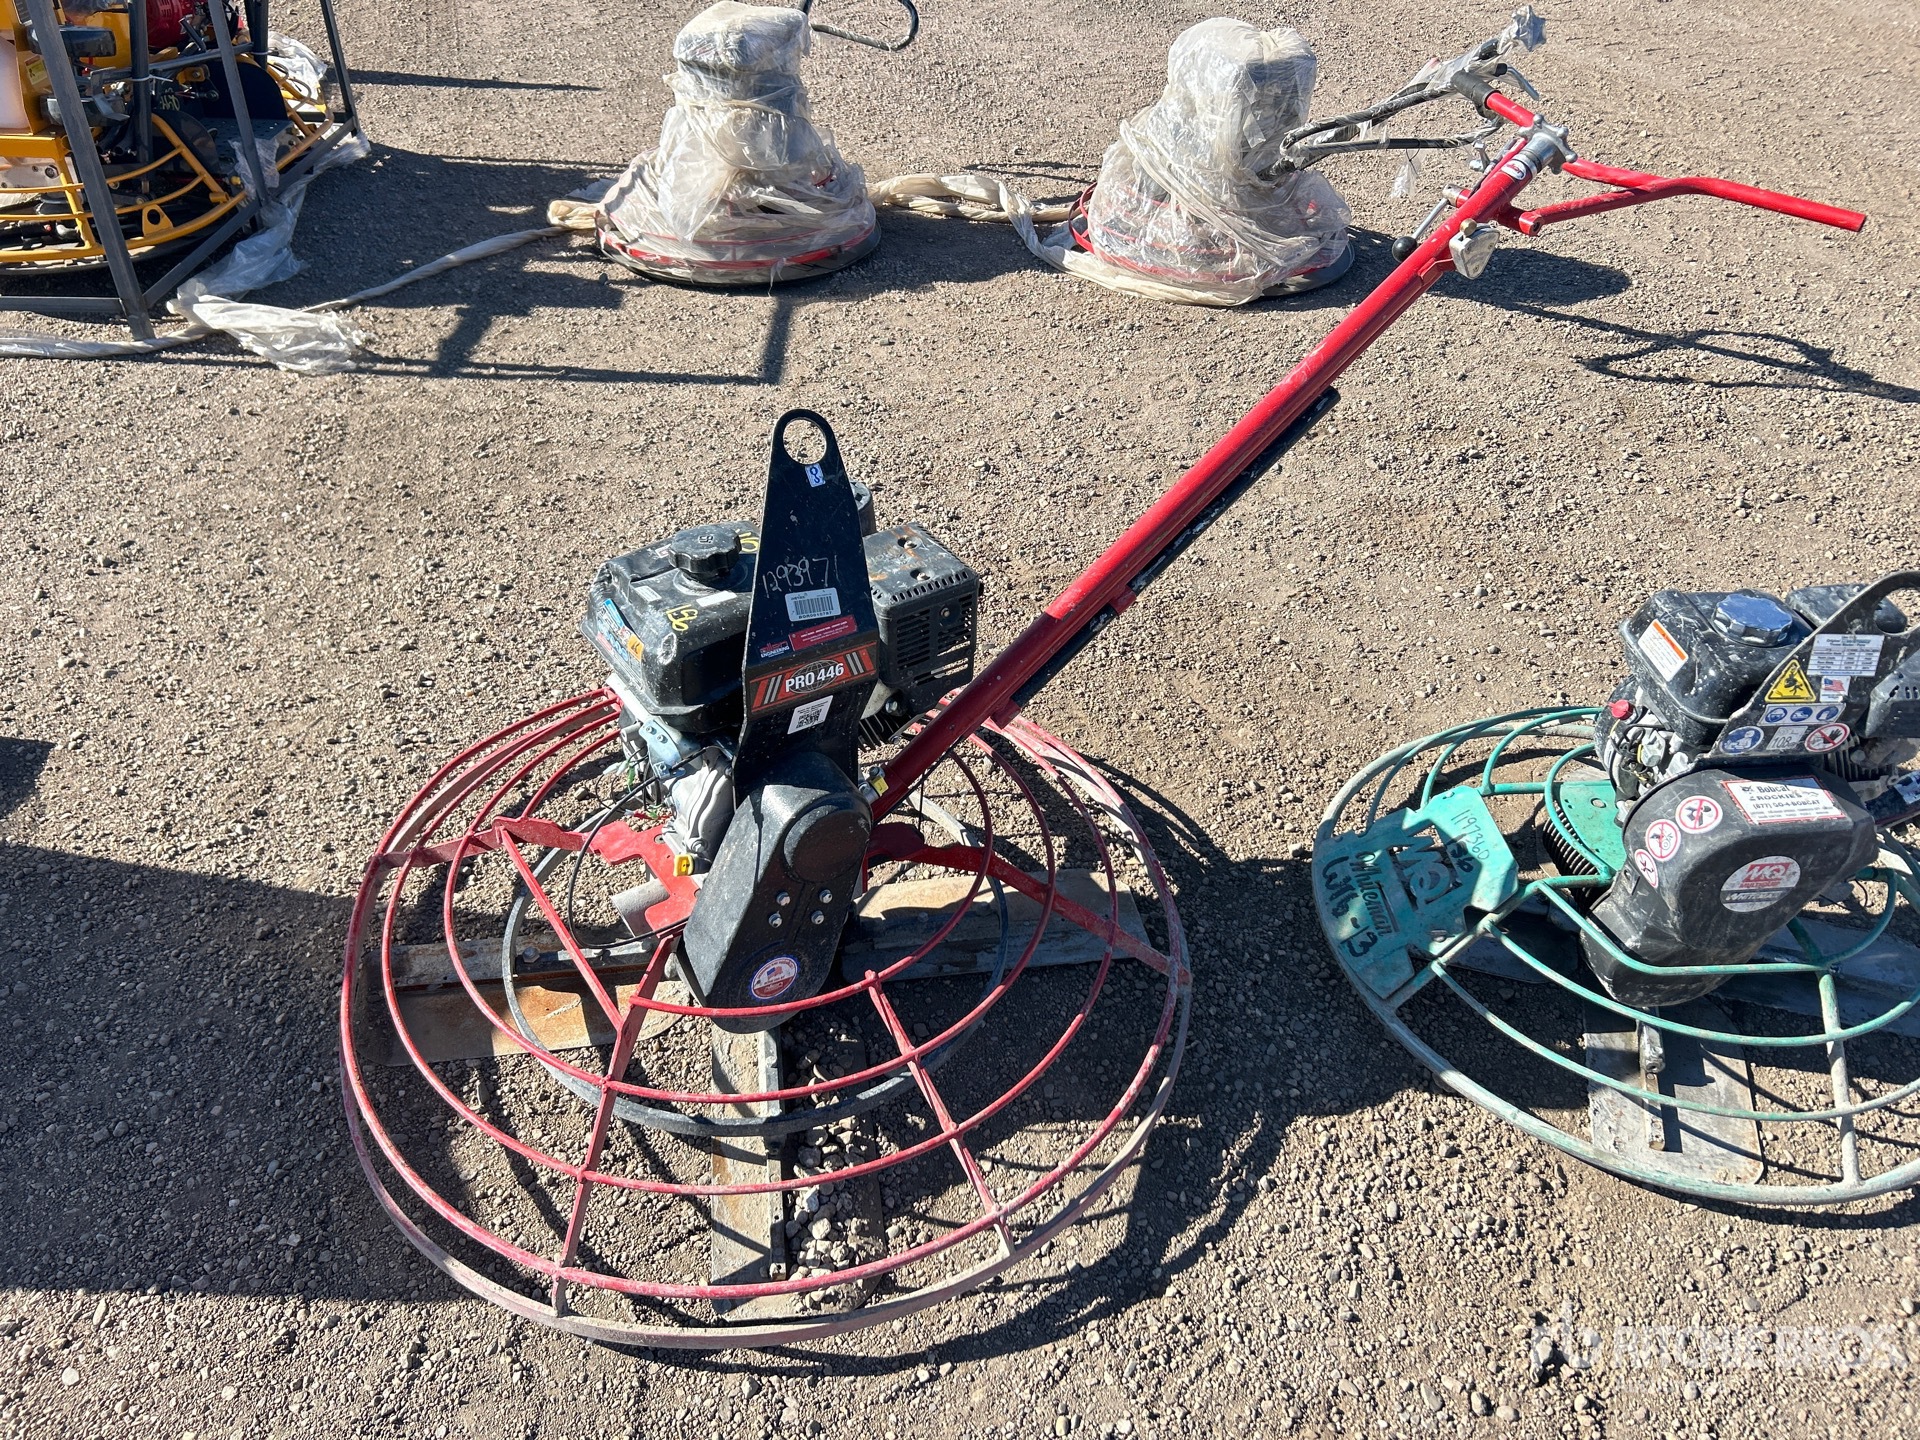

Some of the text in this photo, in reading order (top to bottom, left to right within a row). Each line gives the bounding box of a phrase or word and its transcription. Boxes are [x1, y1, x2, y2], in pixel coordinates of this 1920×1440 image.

[785, 662, 845, 693] PRO 446
[1756, 785, 1790, 794] Bobcat
